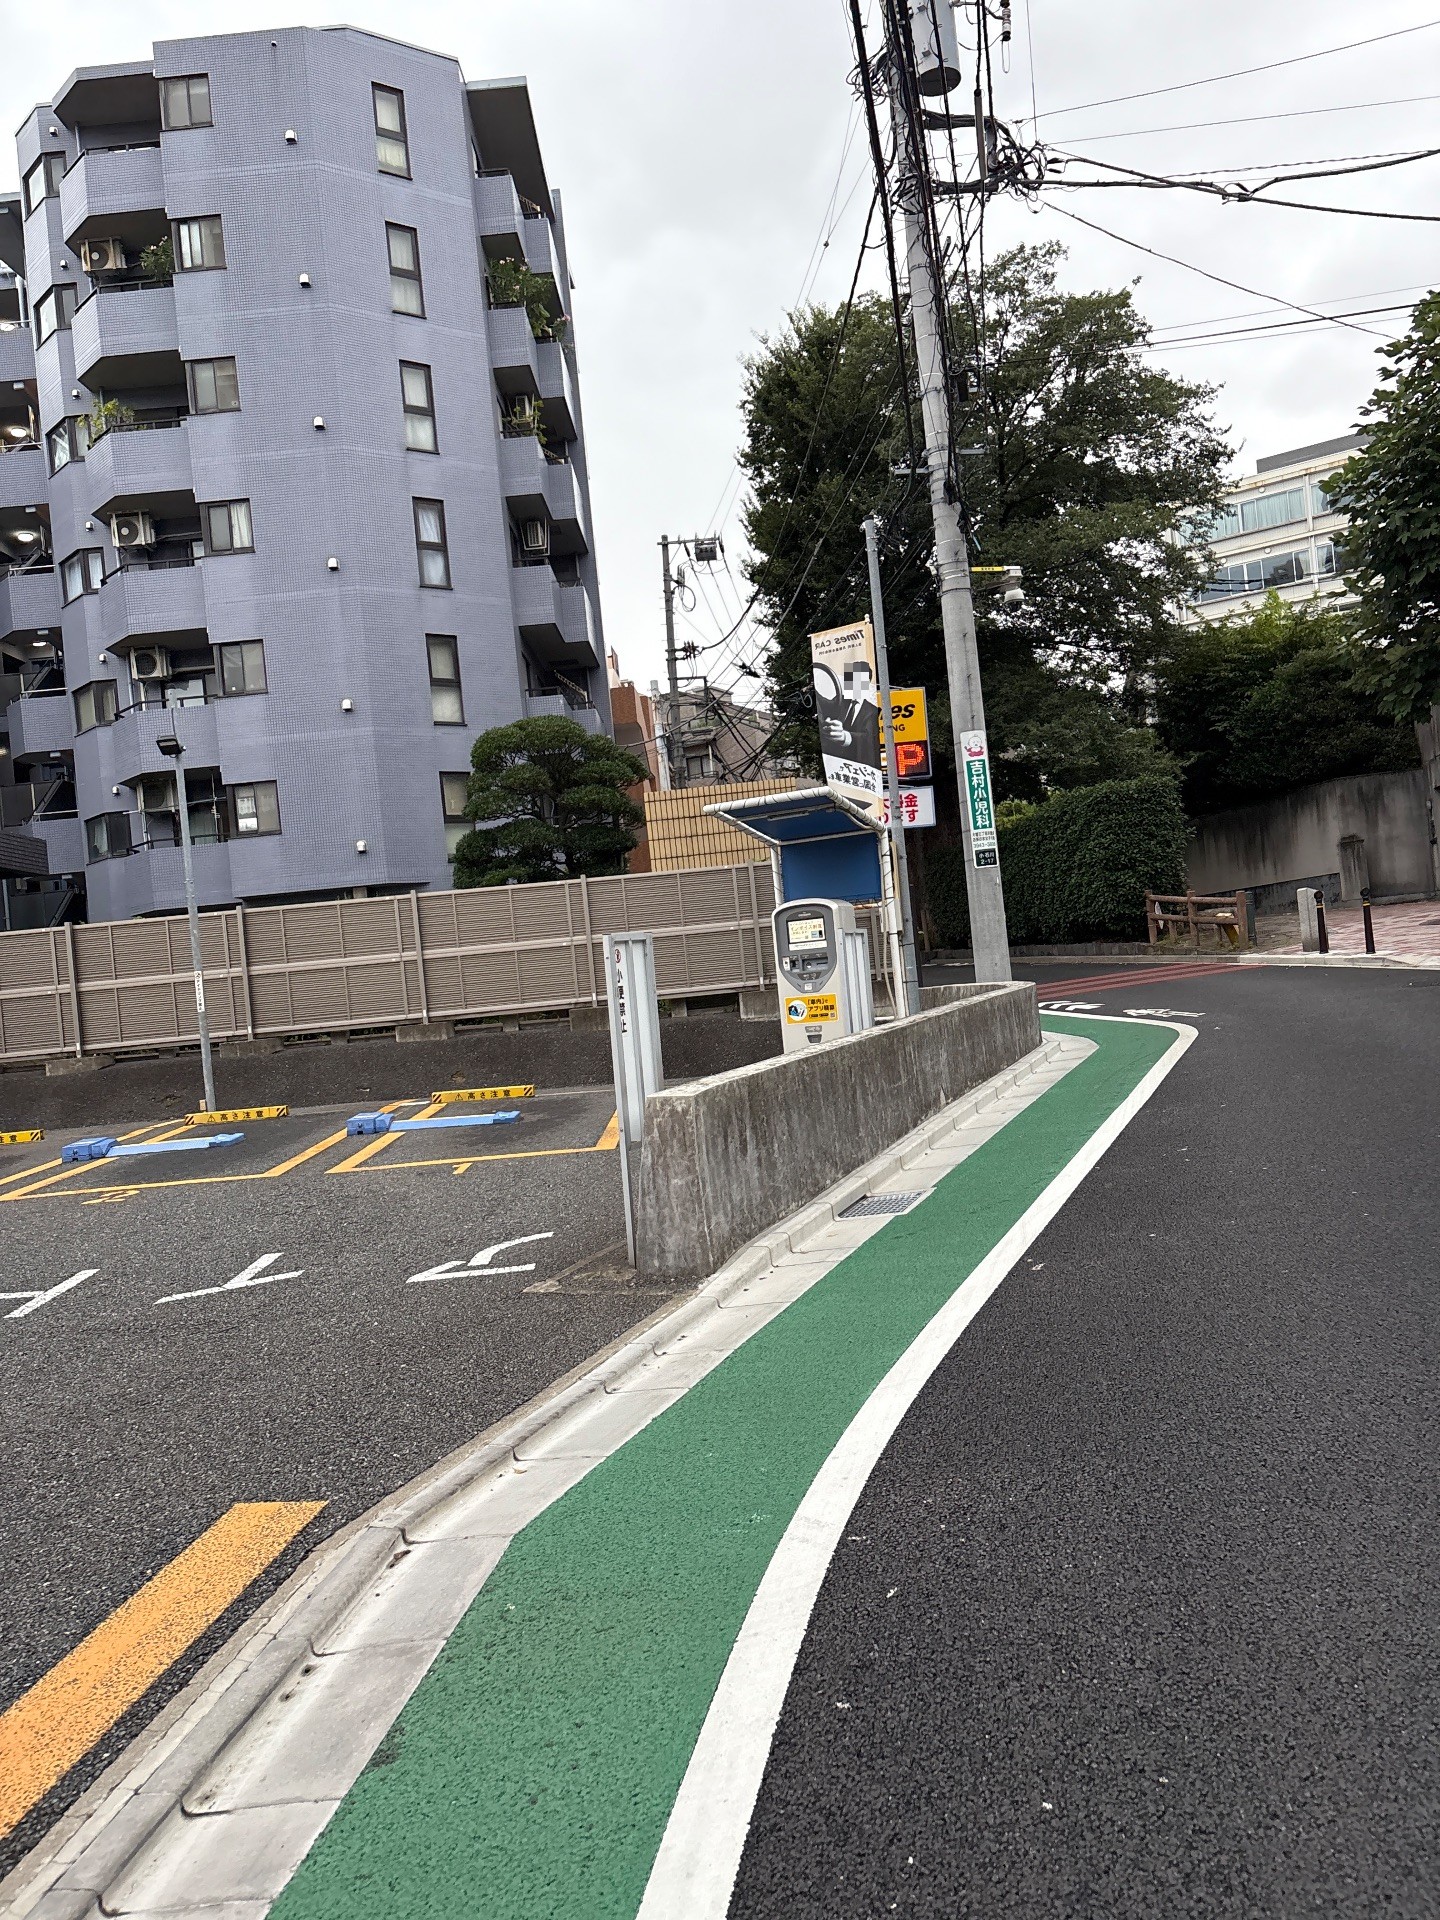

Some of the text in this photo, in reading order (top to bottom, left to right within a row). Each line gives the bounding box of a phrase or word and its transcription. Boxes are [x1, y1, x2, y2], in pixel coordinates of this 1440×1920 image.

[897, 744, 924, 775] P
[970, 761, 990, 829] 吉村小児科
[468, 1089, 511, 1100] 高さ注意
[220, 1110, 264, 1121] 高さ注意
